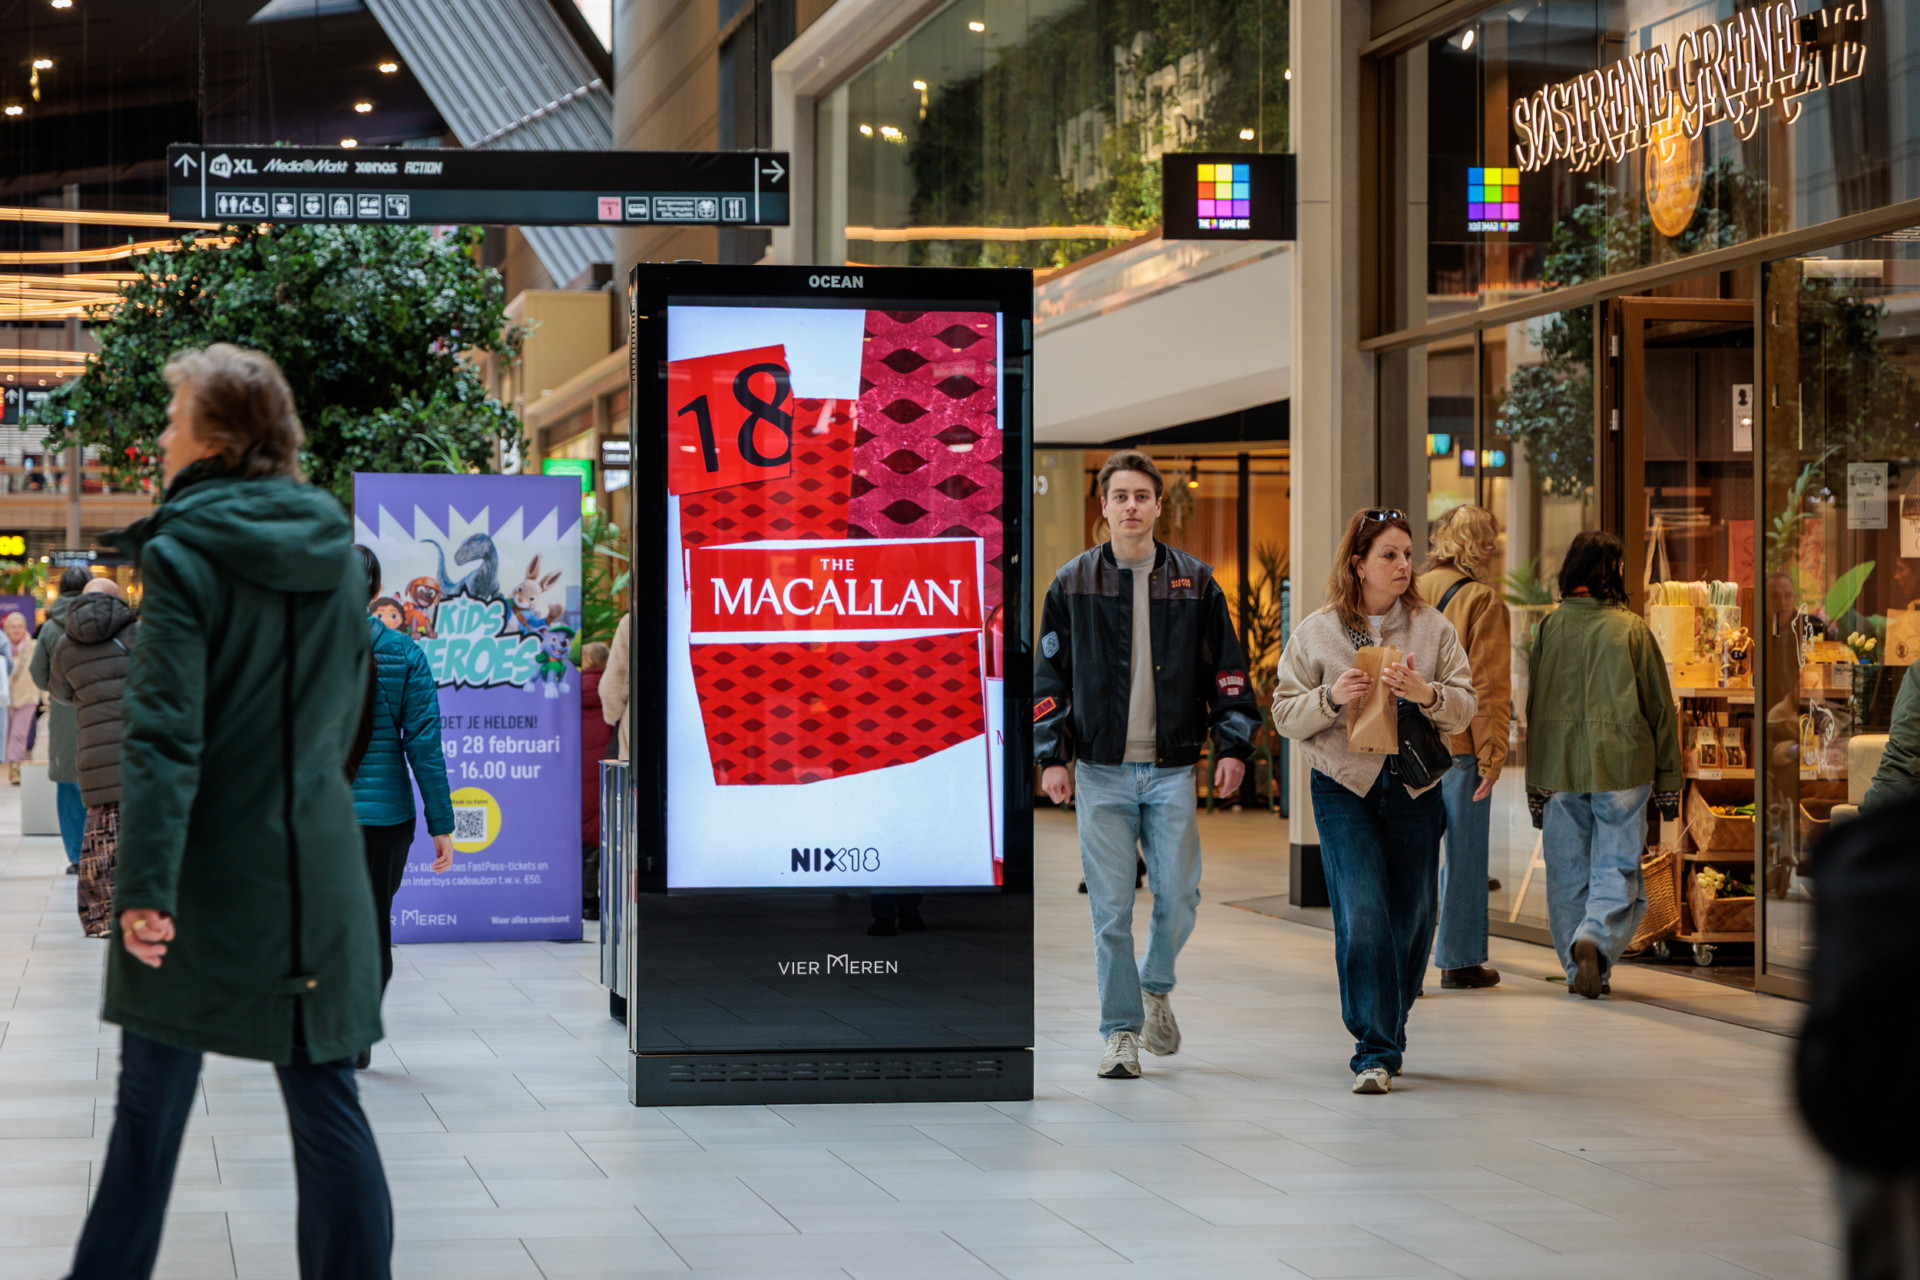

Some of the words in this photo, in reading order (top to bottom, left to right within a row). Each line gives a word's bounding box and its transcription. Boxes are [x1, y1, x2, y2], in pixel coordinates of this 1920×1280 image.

[233, 158, 258, 174] XL
[355, 161, 398, 174] xenos
[607, 206, 613, 216] 1
[809, 275, 864, 288] OCEAN
[677, 362, 793, 473] 18
[820, 558, 855, 571] THE
[711, 578, 962, 616] MACALLAN
[417, 636, 540, 683] EROES
[440, 716, 463, 729] OET
[467, 716, 480, 729] JE
[484, 716, 538, 729] HELDEN!
[462, 735, 484, 754] 28
[489, 735, 560, 753] februari
[460, 761, 506, 779] 16.00
[511, 765, 541, 778] uur
[408, 862, 419, 872] 5x
[467, 861, 537, 872] FastPass-tickets
[537, 862, 549, 871] en
[791, 847, 880, 872] NIX18
[412, 877, 450, 888] Intertoys
[451, 875, 497, 885] cadeaubon
[778, 961, 820, 975] VIER
[827, 953, 899, 975] MEREN
